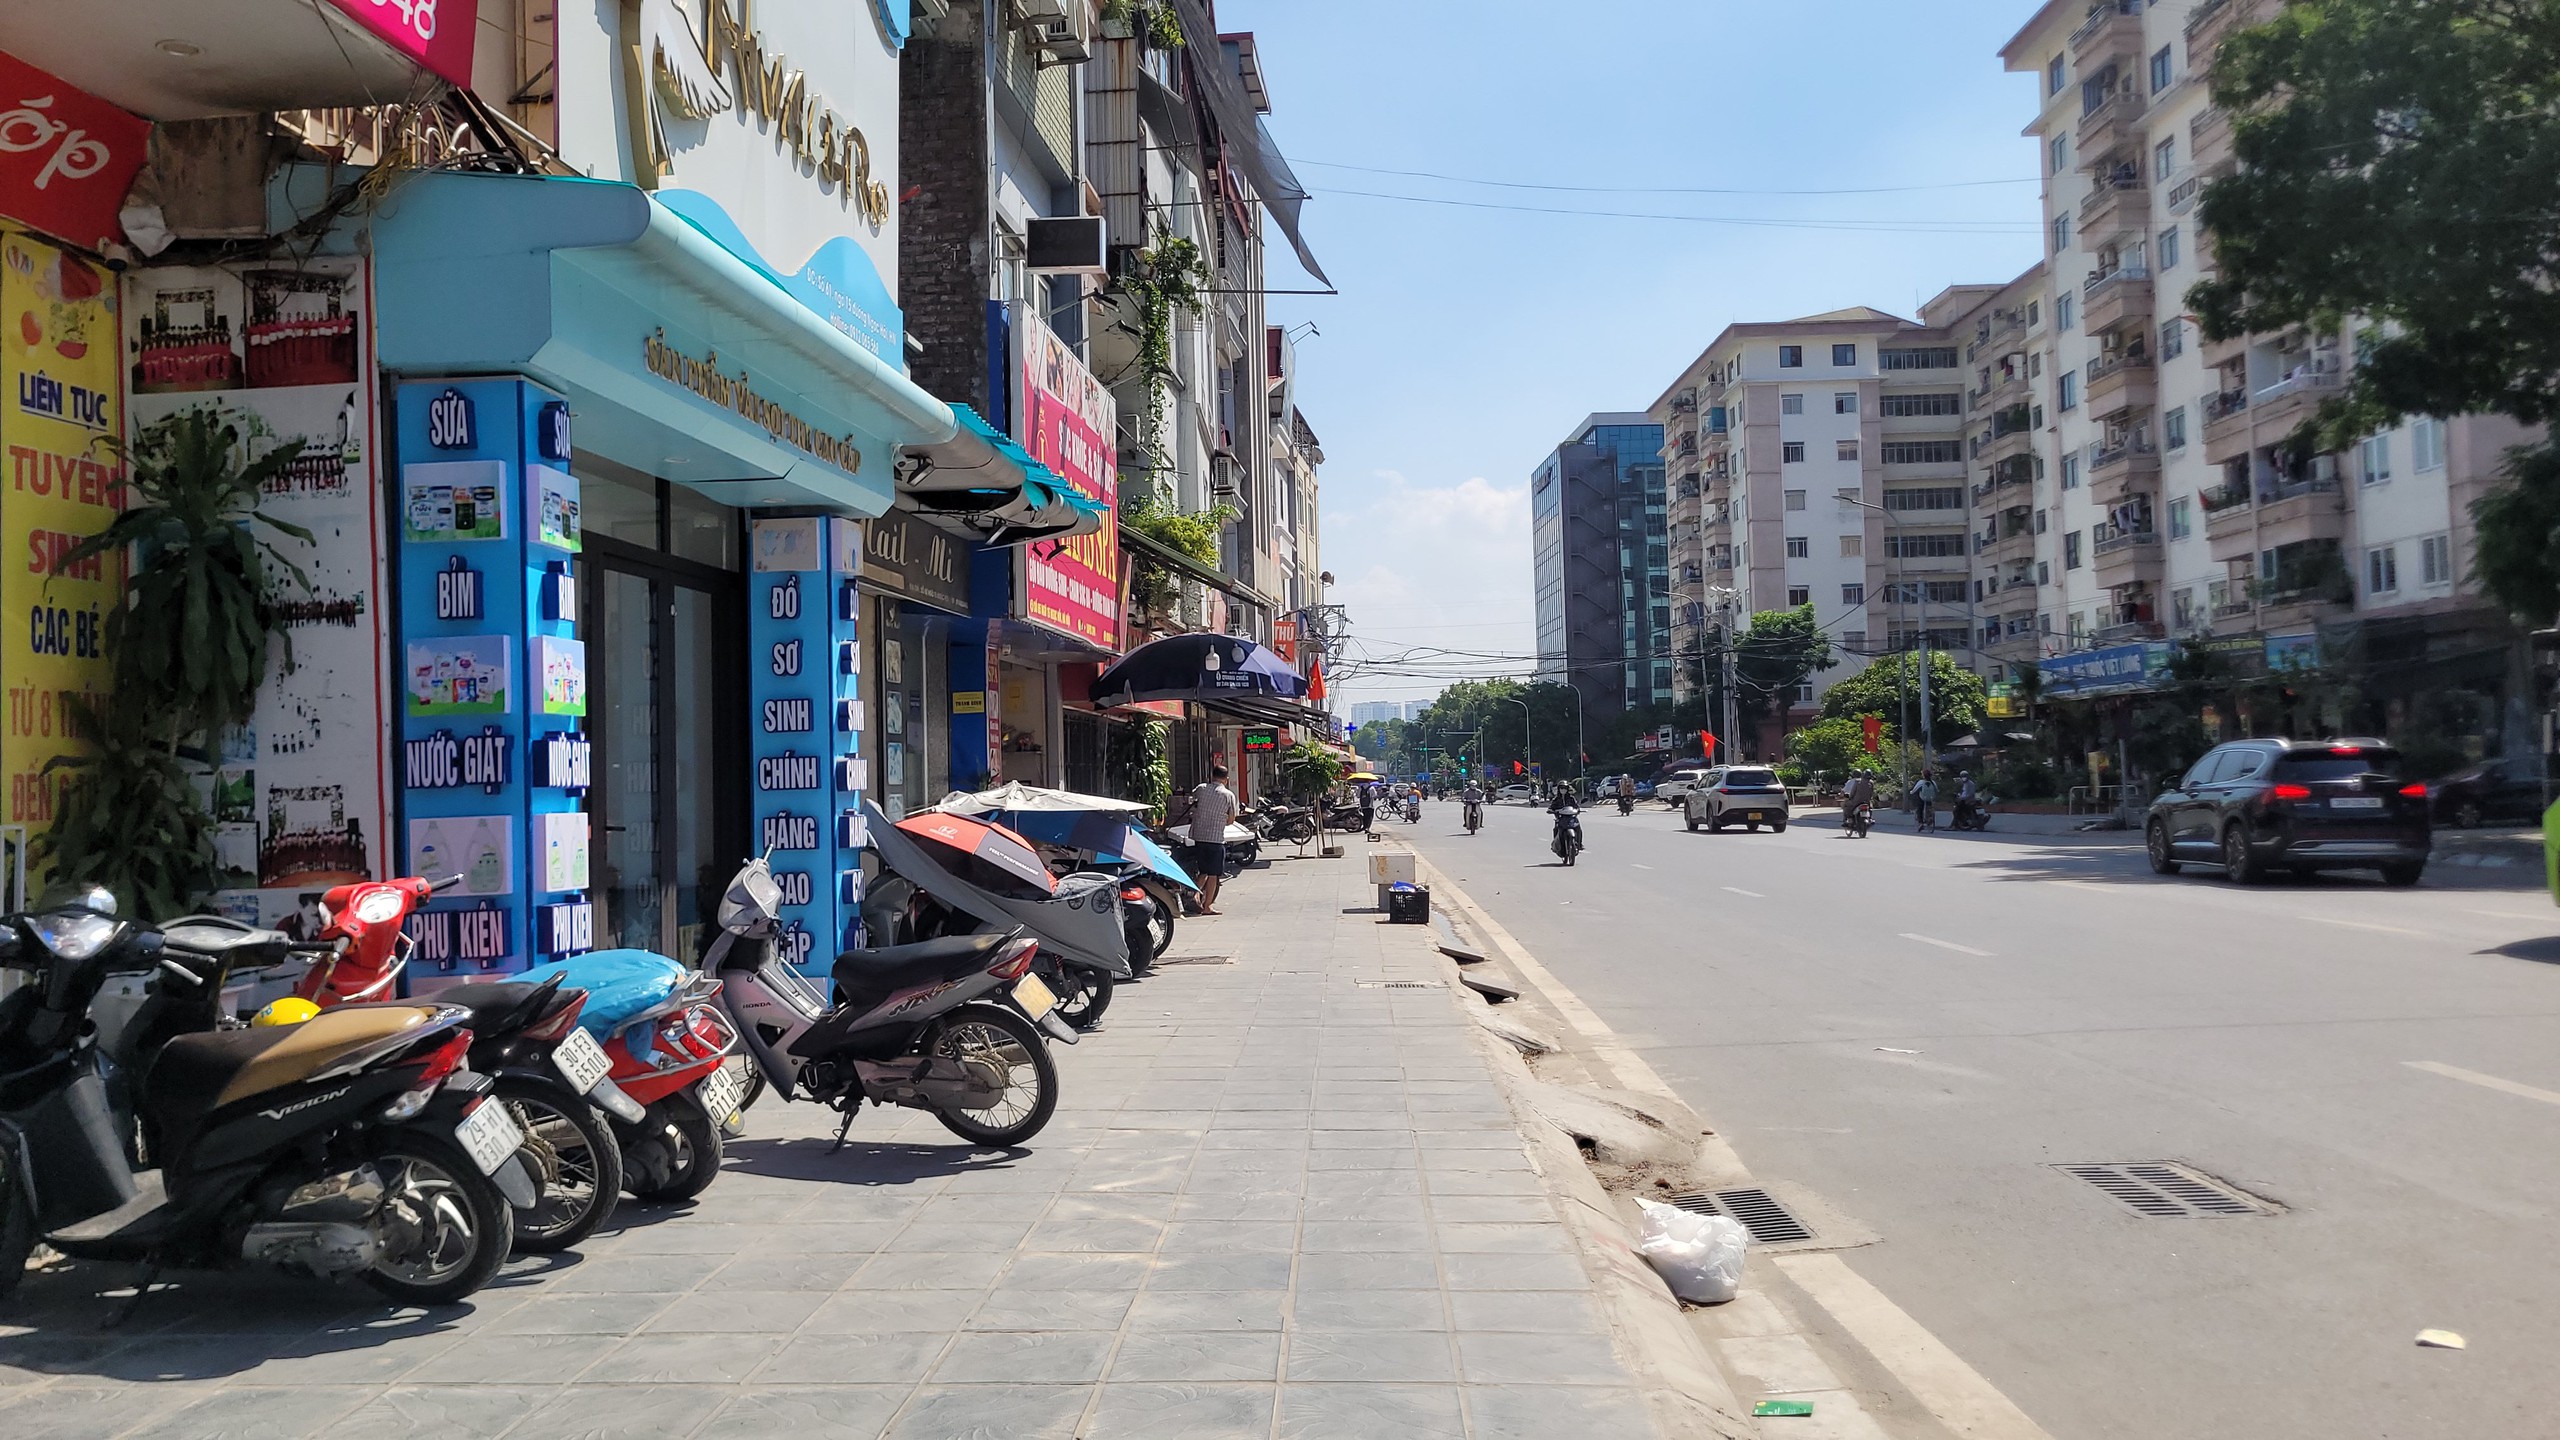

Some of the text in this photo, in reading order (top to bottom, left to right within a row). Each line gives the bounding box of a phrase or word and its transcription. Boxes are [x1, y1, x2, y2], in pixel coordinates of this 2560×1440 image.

[20, 370, 108, 430] LIÊN TỤC
[431, 391, 469, 446] SỮA
[555, 404, 572, 460] SỮA
[28, 529, 102, 583] SINH
[924, 534, 954, 583] Mi
[438, 556, 475, 619] BỈM
[558, 560, 576, 622] BỈM
[772, 576, 798, 618] ĐỒ
[850, 579, 860, 621] ĐỒ
[31, 597, 100, 659] CÁC BÉ
[1274, 623, 1295, 642] THÚ
[772, 641, 799, 675] SƠ
[850, 640, 861, 675] SƠ
[9, 677, 36, 737] TỪ
[40, 690, 52, 737] 8
[764, 700, 810, 732] SINH
[848, 700, 865, 732] SINH
[406, 727, 505, 793] NƯỚC GIẶT
[548, 731, 591, 797] NƯỚC GIẶT
[758, 752, 818, 790] CHÍNH
[846, 753, 868, 792] CHÍNH
[763, 813, 816, 850] HÃNG
[411, 901, 504, 970] PHỤ KIỆN
[553, 904, 571, 960] PHỤ
[742, 1001, 772, 1009] HONDA
[575, 1052, 607, 1086] 6500
[256, 1086, 352, 1121] VISION
[710, 1082, 740, 1121] 011.07
[464, 1104, 503, 1146] 29-H1
[476, 1121, 521, 1169] 330.11
